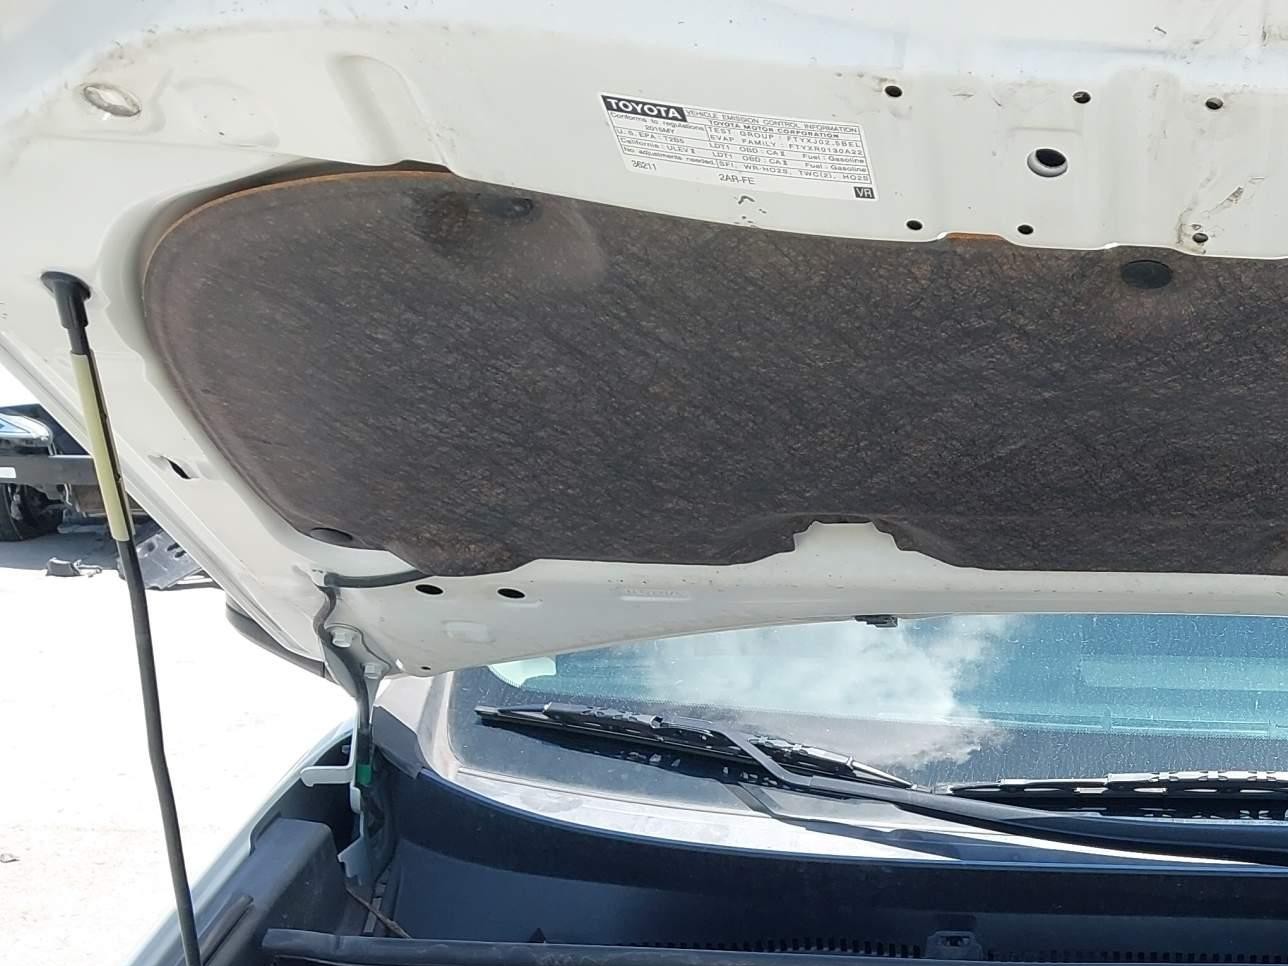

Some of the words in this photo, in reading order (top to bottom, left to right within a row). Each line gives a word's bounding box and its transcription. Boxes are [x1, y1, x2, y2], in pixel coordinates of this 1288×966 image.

[607, 98, 683, 119] TOYOTA
[709, 120, 741, 128] TOYOTA
[743, 124, 774, 132] MOTOR
[777, 128, 840, 138] CORPORATION
[740, 130, 774, 139] GROUP
[718, 173, 756, 185] 2AR-FE
[856, 186, 873, 199] VR
